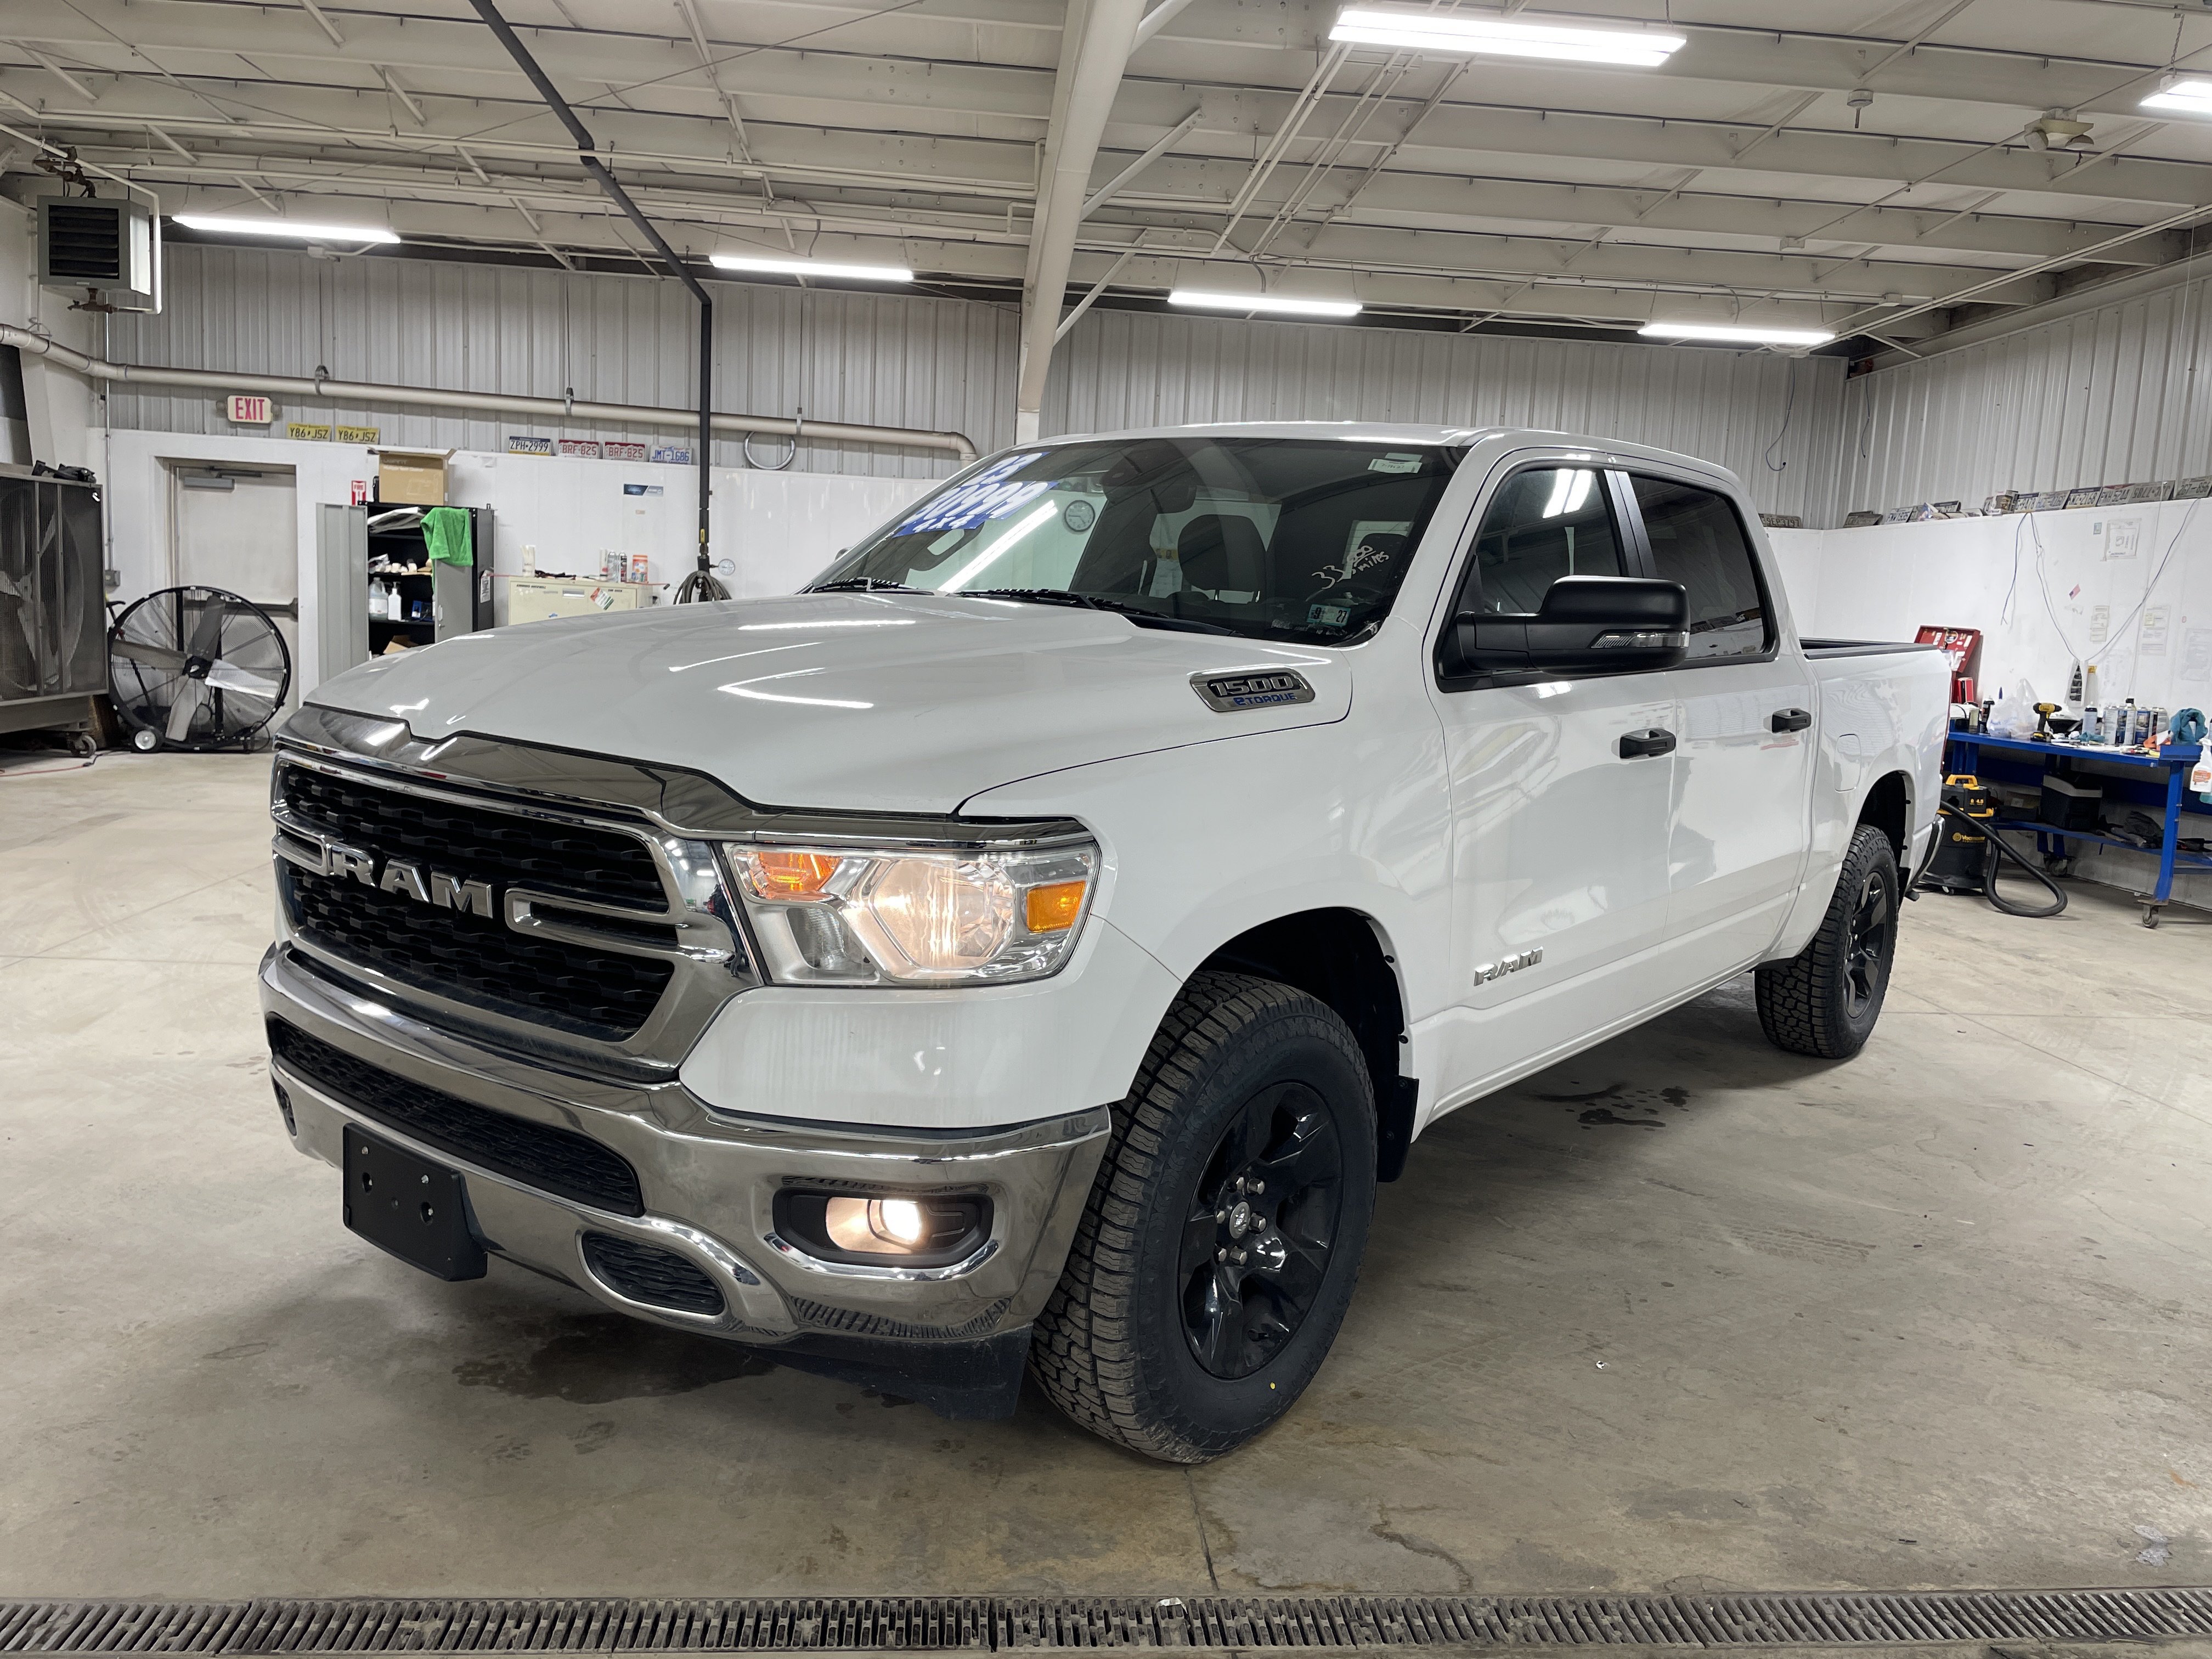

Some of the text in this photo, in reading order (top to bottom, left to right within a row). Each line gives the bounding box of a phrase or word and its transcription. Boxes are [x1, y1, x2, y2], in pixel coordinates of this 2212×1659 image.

[235, 397, 265, 421] EXIT
[1335, 610, 1348, 623] 27
[1210, 675, 1294, 696] 1500
[331, 840, 493, 919] RAM
[1474, 946, 1544, 986] RAM
